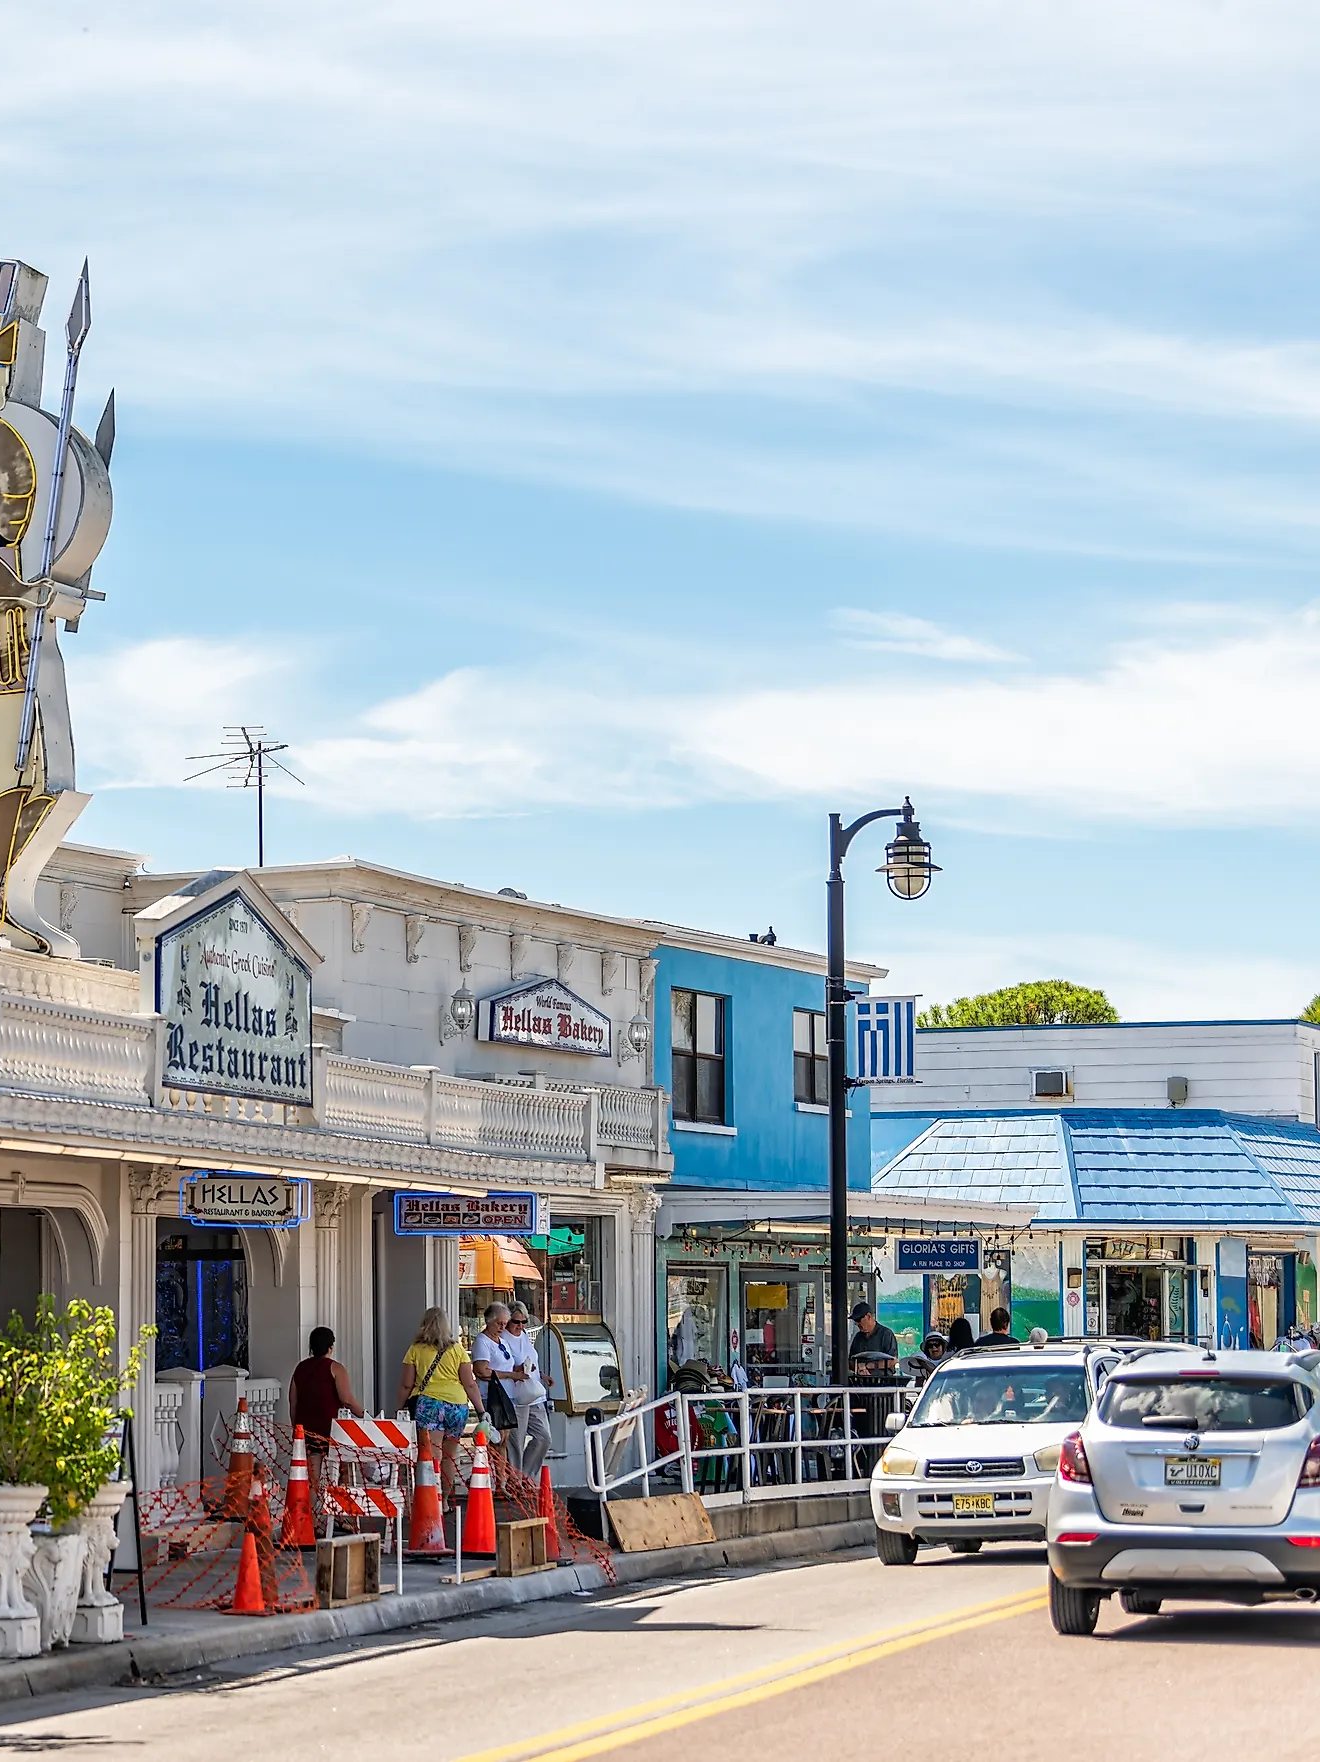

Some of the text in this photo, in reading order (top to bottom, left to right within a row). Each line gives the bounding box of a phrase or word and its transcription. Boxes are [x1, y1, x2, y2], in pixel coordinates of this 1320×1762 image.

[232, 950, 252, 974] Greek
[199, 981, 277, 1038] Hellas
[536, 995, 572, 1012] World Famous
[501, 1005, 604, 1049] Hellas Bakery
[167, 1021, 307, 1090] Restaurant
[202, 1184, 279, 1206] HELLAS
[203, 1207, 277, 1218] RESTAURANT & BAKERY
[406, 1199, 528, 1214] Hellas Bakery
[483, 1215, 524, 1224] OPEN
[902, 1243, 975, 1254] GLORIA'S GIFTS
